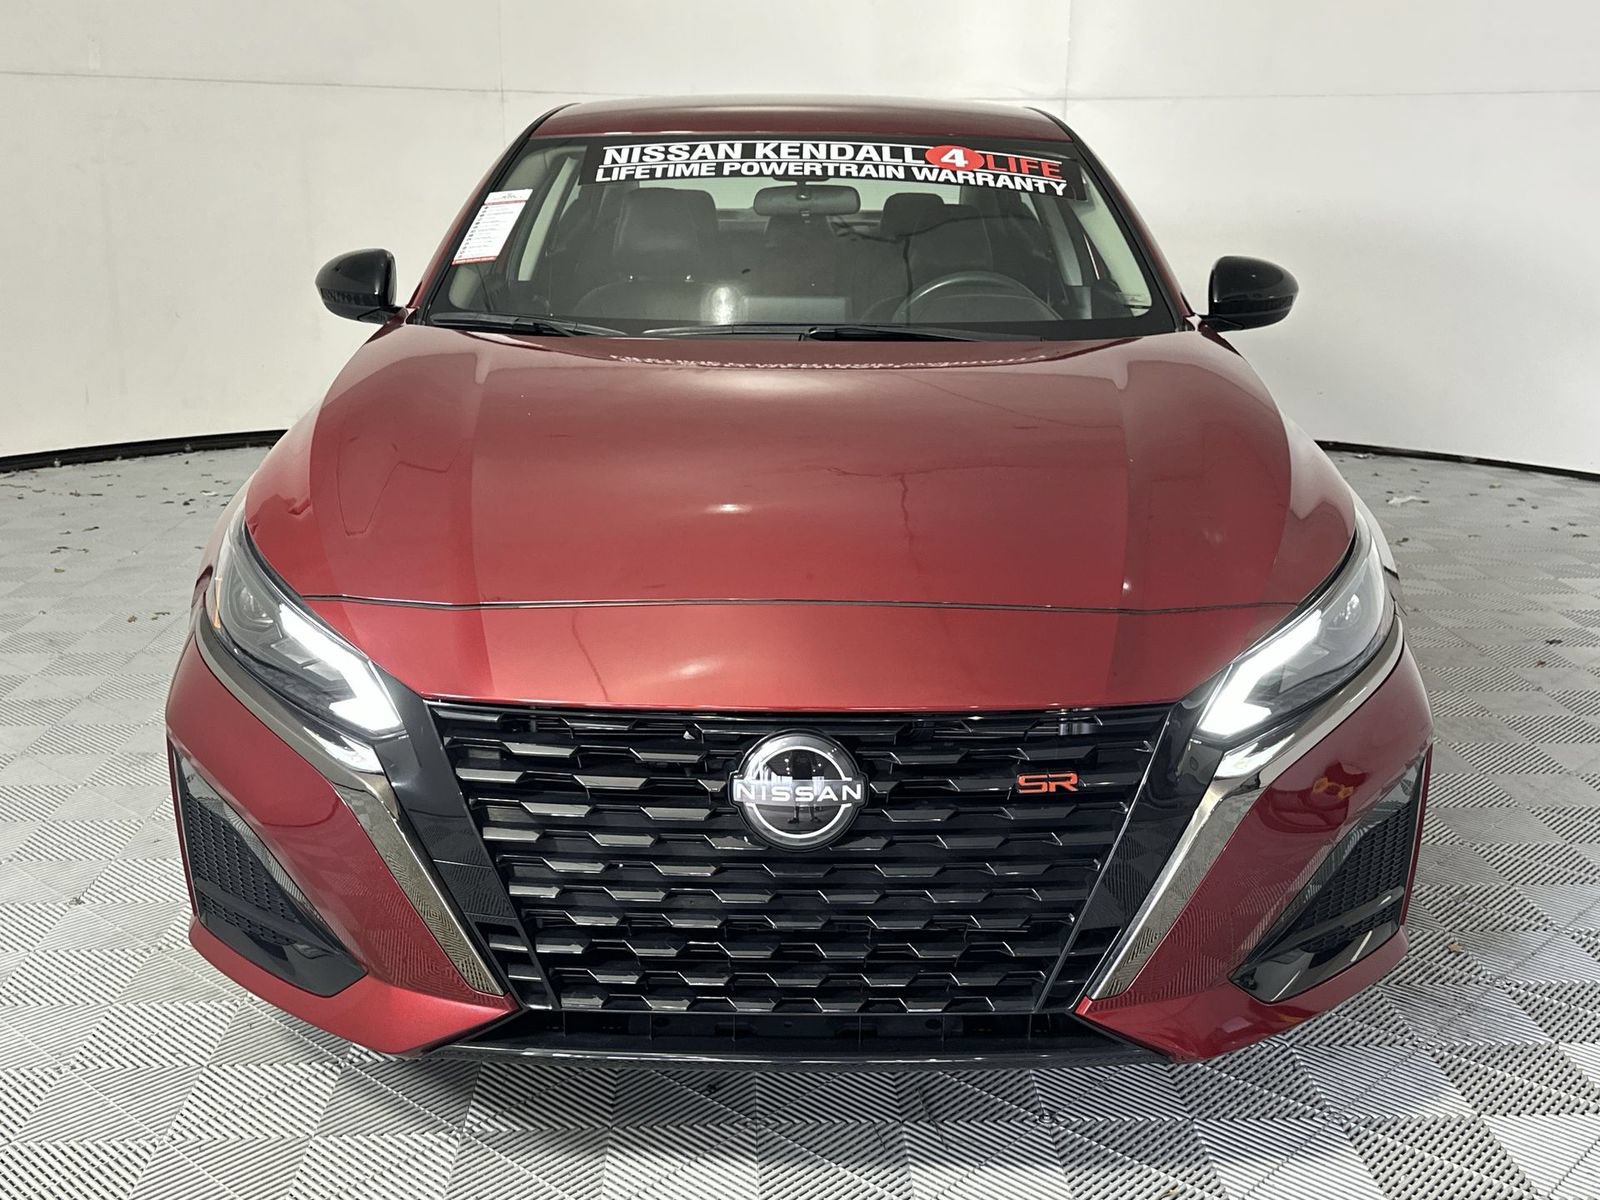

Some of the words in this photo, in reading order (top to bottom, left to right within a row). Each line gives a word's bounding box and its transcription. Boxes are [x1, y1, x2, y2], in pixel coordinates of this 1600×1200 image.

[603, 143, 743, 165] NISSAN
[754, 143, 926, 164] KENDALL
[941, 149, 969, 167] 4
[987, 154, 1063, 180] LIFE
[595, 162, 717, 182] LIFETIME
[722, 162, 904, 179] POWERTRAIN
[911, 167, 1067, 197] WARRANTY
[735, 783, 862, 802] NISSAN
[1018, 772, 1078, 794] SR
